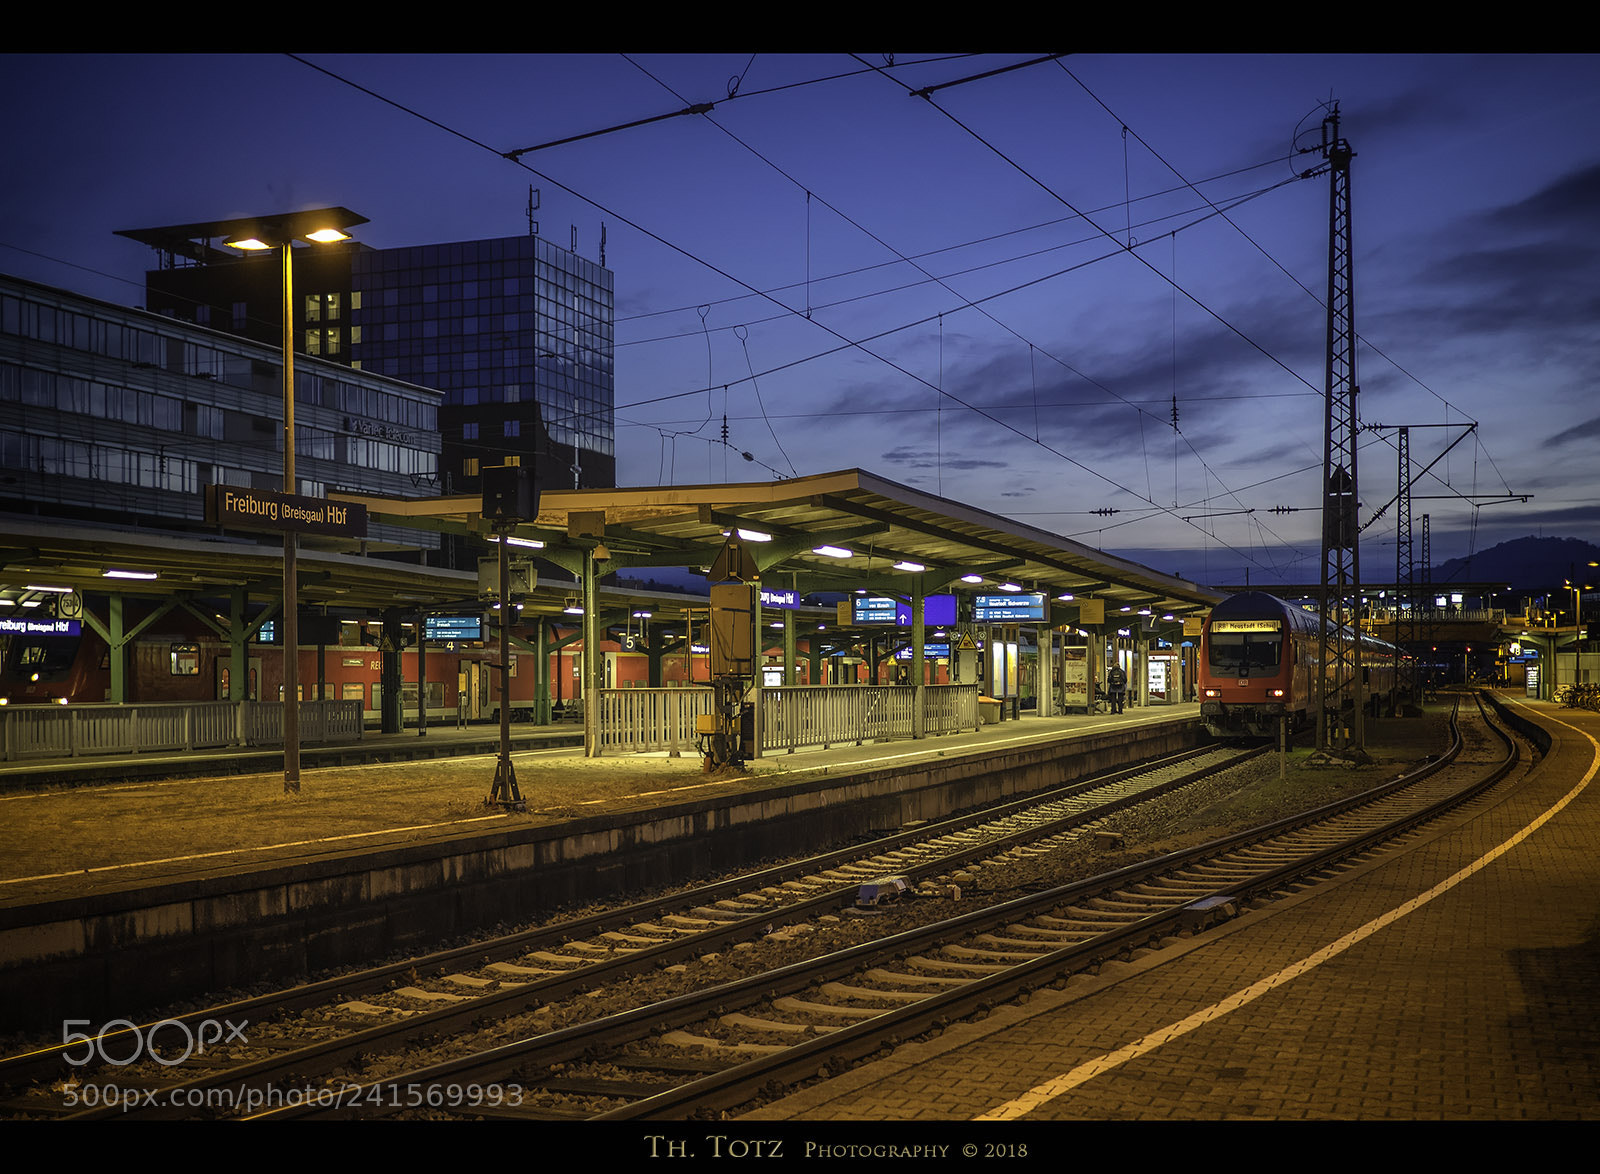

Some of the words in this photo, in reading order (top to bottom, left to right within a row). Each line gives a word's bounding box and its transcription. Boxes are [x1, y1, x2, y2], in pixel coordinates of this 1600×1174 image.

[225, 492, 278, 521] Freiburg
[281, 502, 324, 524] (Breisgau)
[327, 505, 347, 525] Hbf
[55, 621, 69, 632] Hbf
[475, 617, 481, 626] 5
[1148, 614, 1158, 628] 7
[446, 641, 455, 651] 4
[626, 636, 634, 649] 5
